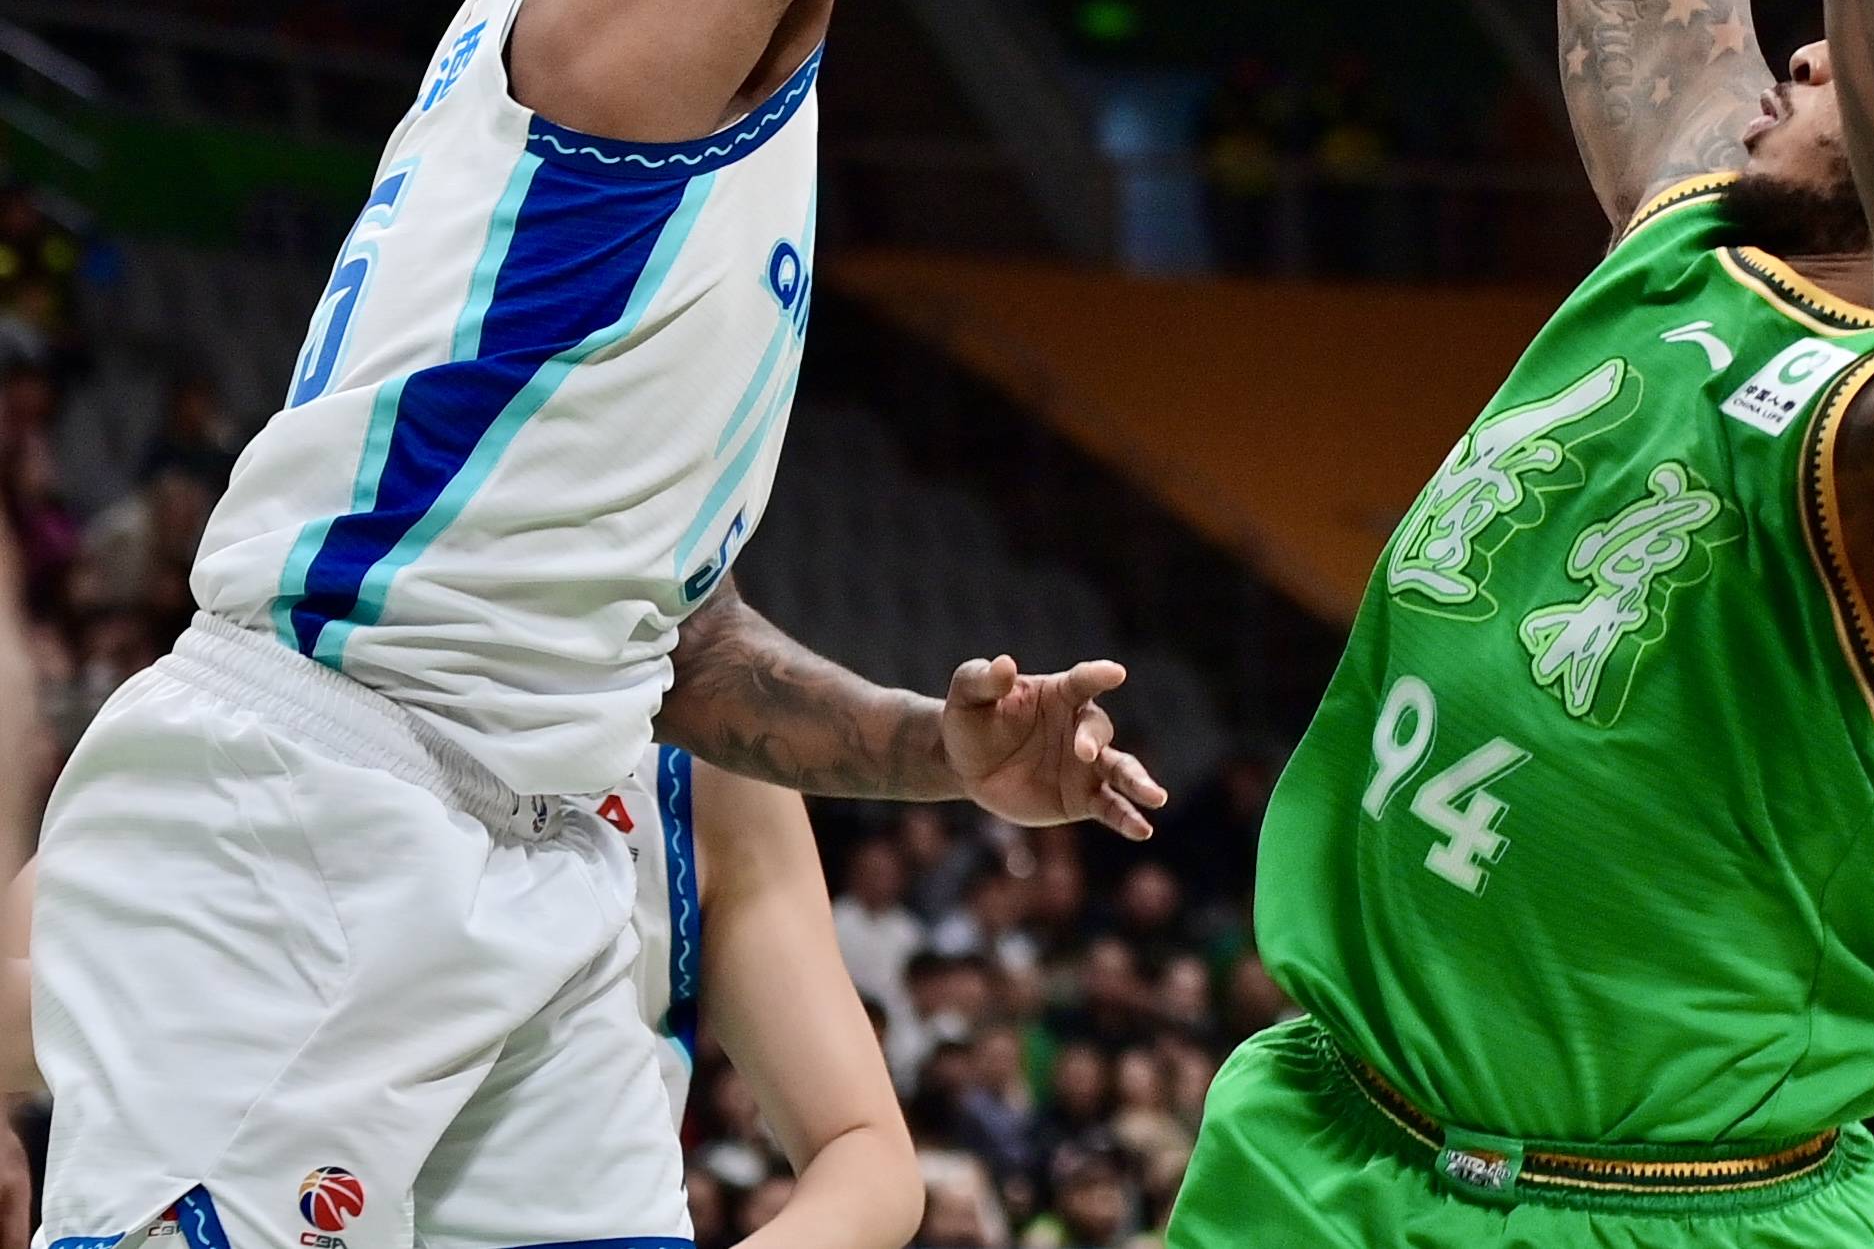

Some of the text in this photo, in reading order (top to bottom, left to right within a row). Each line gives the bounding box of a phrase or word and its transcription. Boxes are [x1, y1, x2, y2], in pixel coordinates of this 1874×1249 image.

[1732, 398, 1762, 416] CHINA
[1361, 674, 1535, 900] 94
[300, 1231, 349, 1249] CBA
